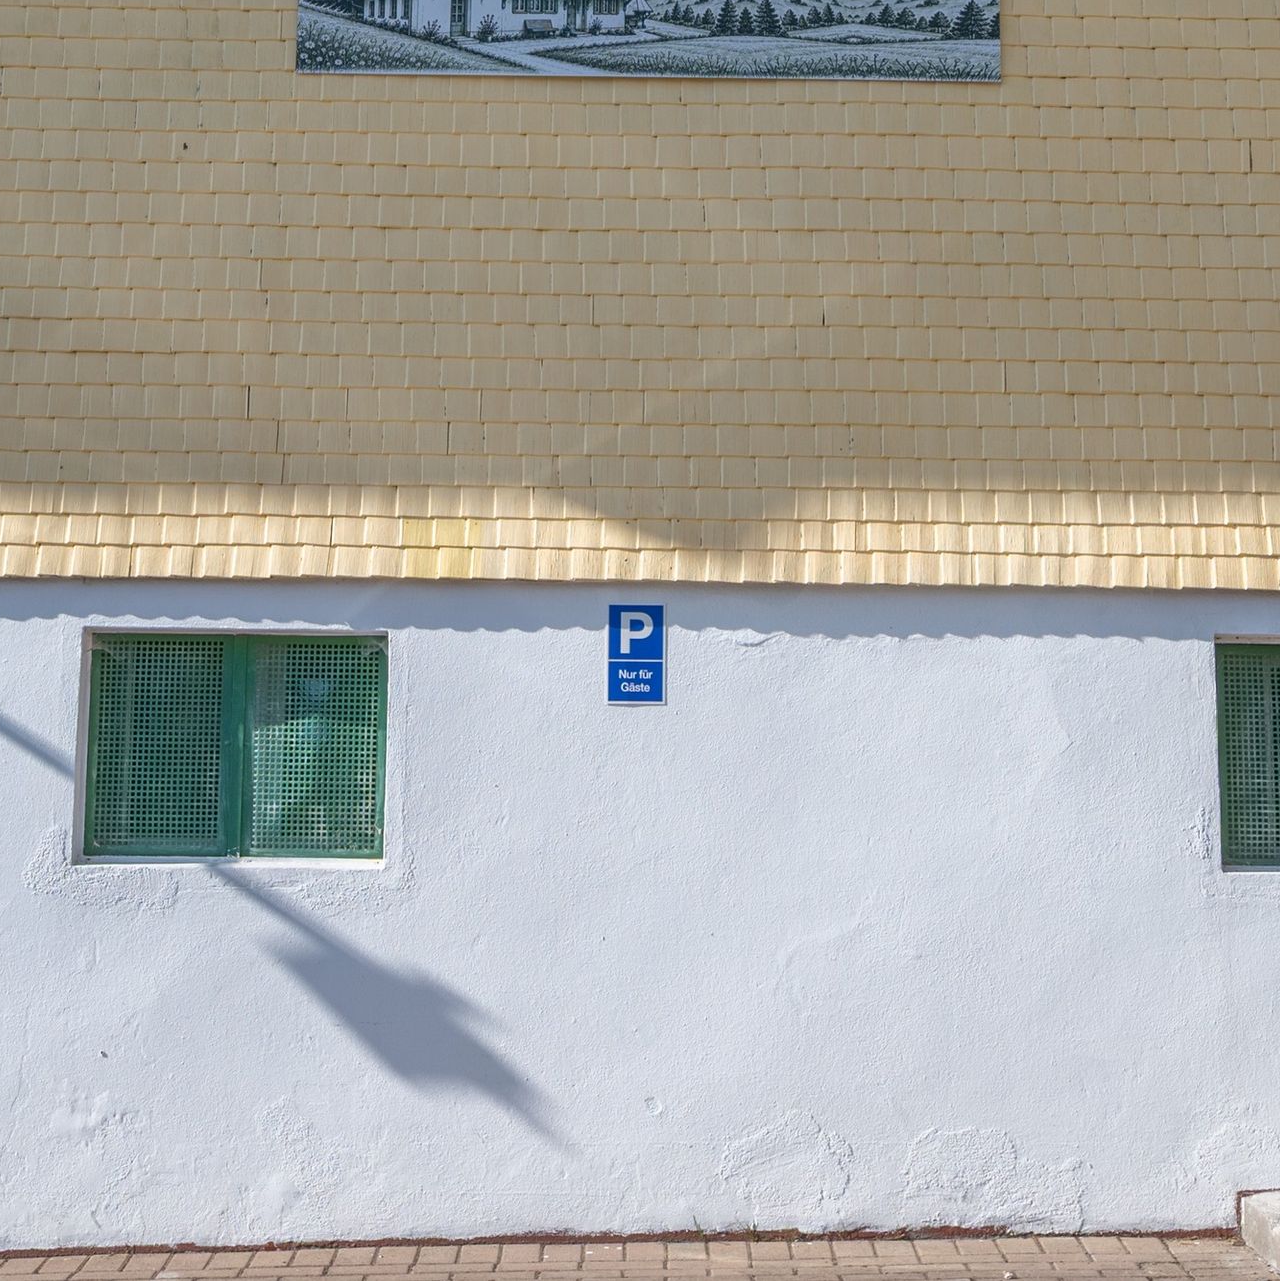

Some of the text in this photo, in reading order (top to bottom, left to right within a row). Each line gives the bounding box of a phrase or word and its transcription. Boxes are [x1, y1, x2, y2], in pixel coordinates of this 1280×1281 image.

[620, 611, 654, 654] P
[618, 669, 653, 679] Nur für
[620, 681, 651, 693] Gäste
